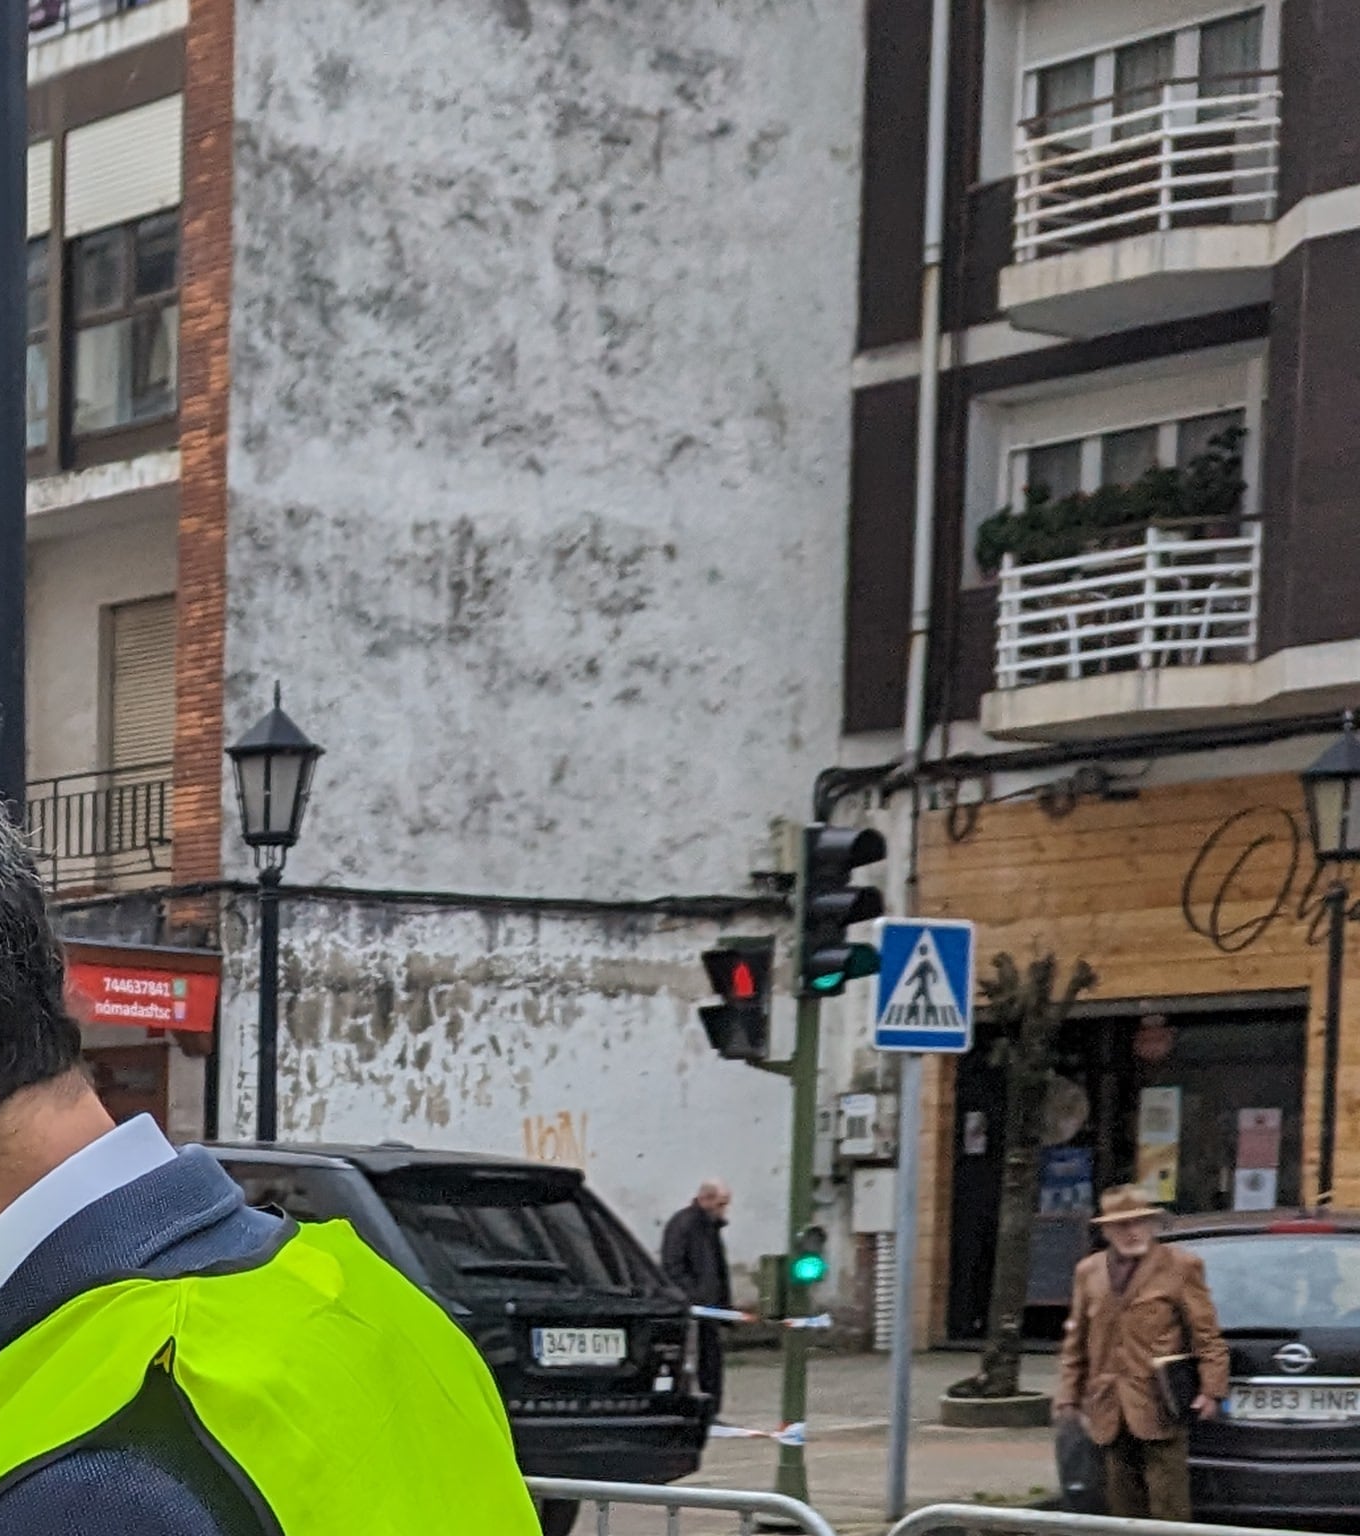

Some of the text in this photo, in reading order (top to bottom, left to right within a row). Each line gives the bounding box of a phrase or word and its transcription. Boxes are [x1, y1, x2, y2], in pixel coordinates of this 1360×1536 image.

[546, 1332, 587, 1354] 3478
[1237, 1389, 1357, 1411] 7883 HNR
